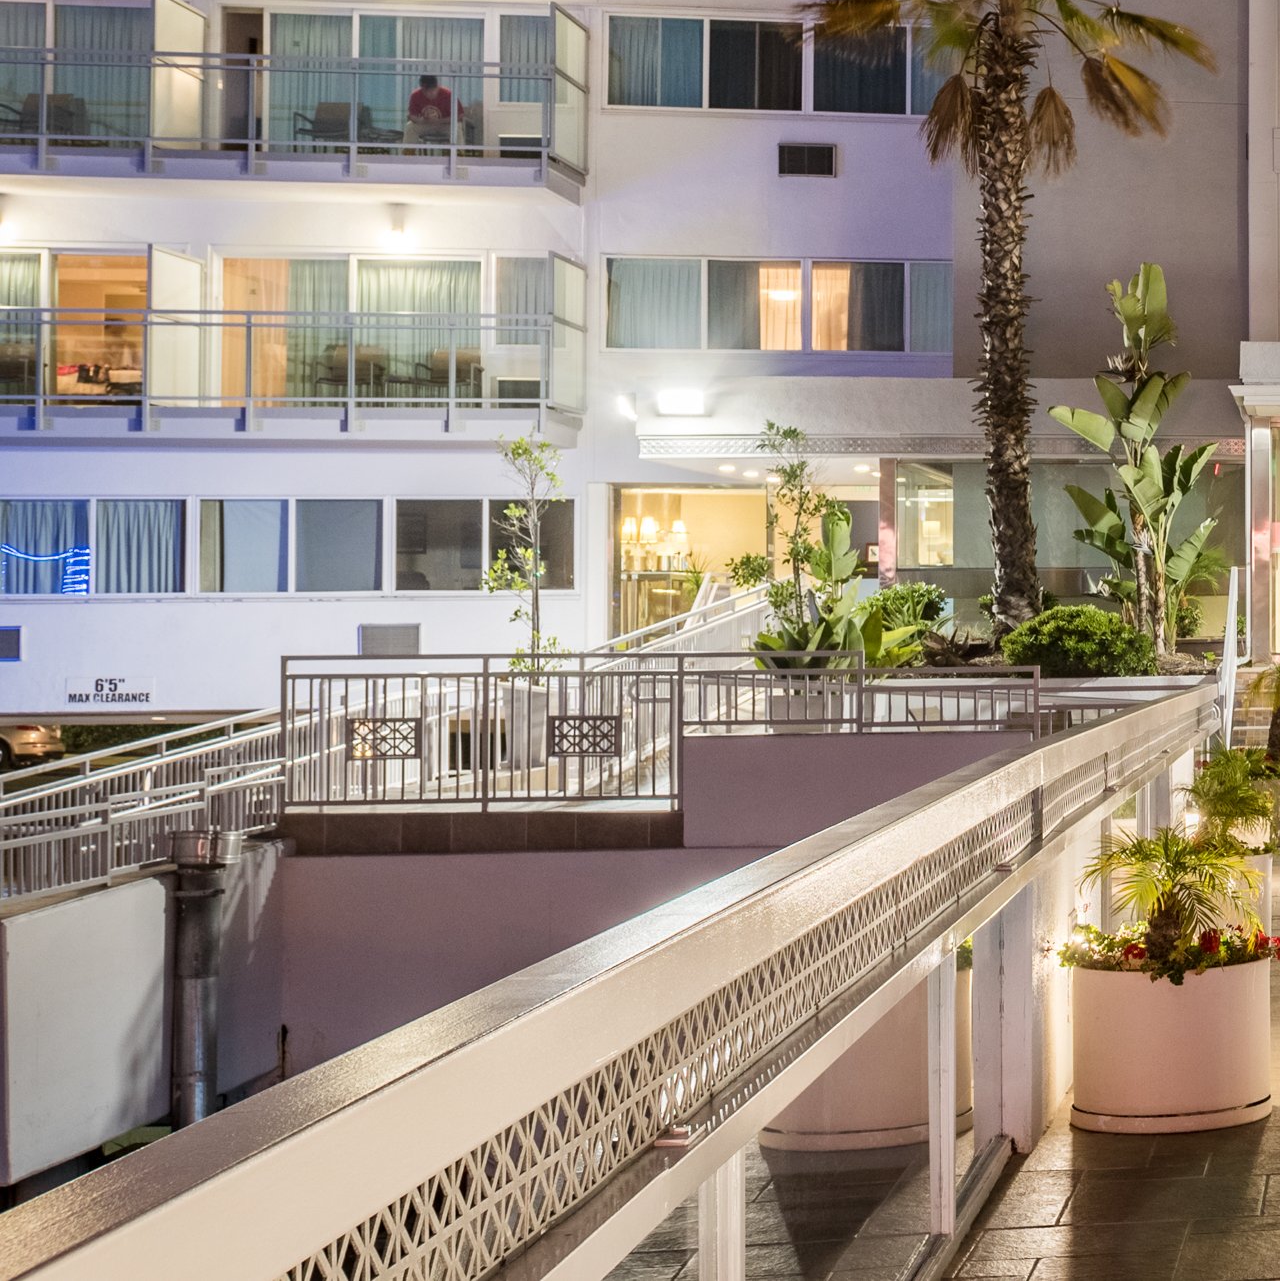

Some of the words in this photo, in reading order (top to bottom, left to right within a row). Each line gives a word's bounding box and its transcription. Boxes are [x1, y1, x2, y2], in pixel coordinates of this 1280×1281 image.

[94, 677, 126, 693] 6'5"
[67, 692, 91, 703] MAX
[93, 692, 151, 703] CLEARANCE
